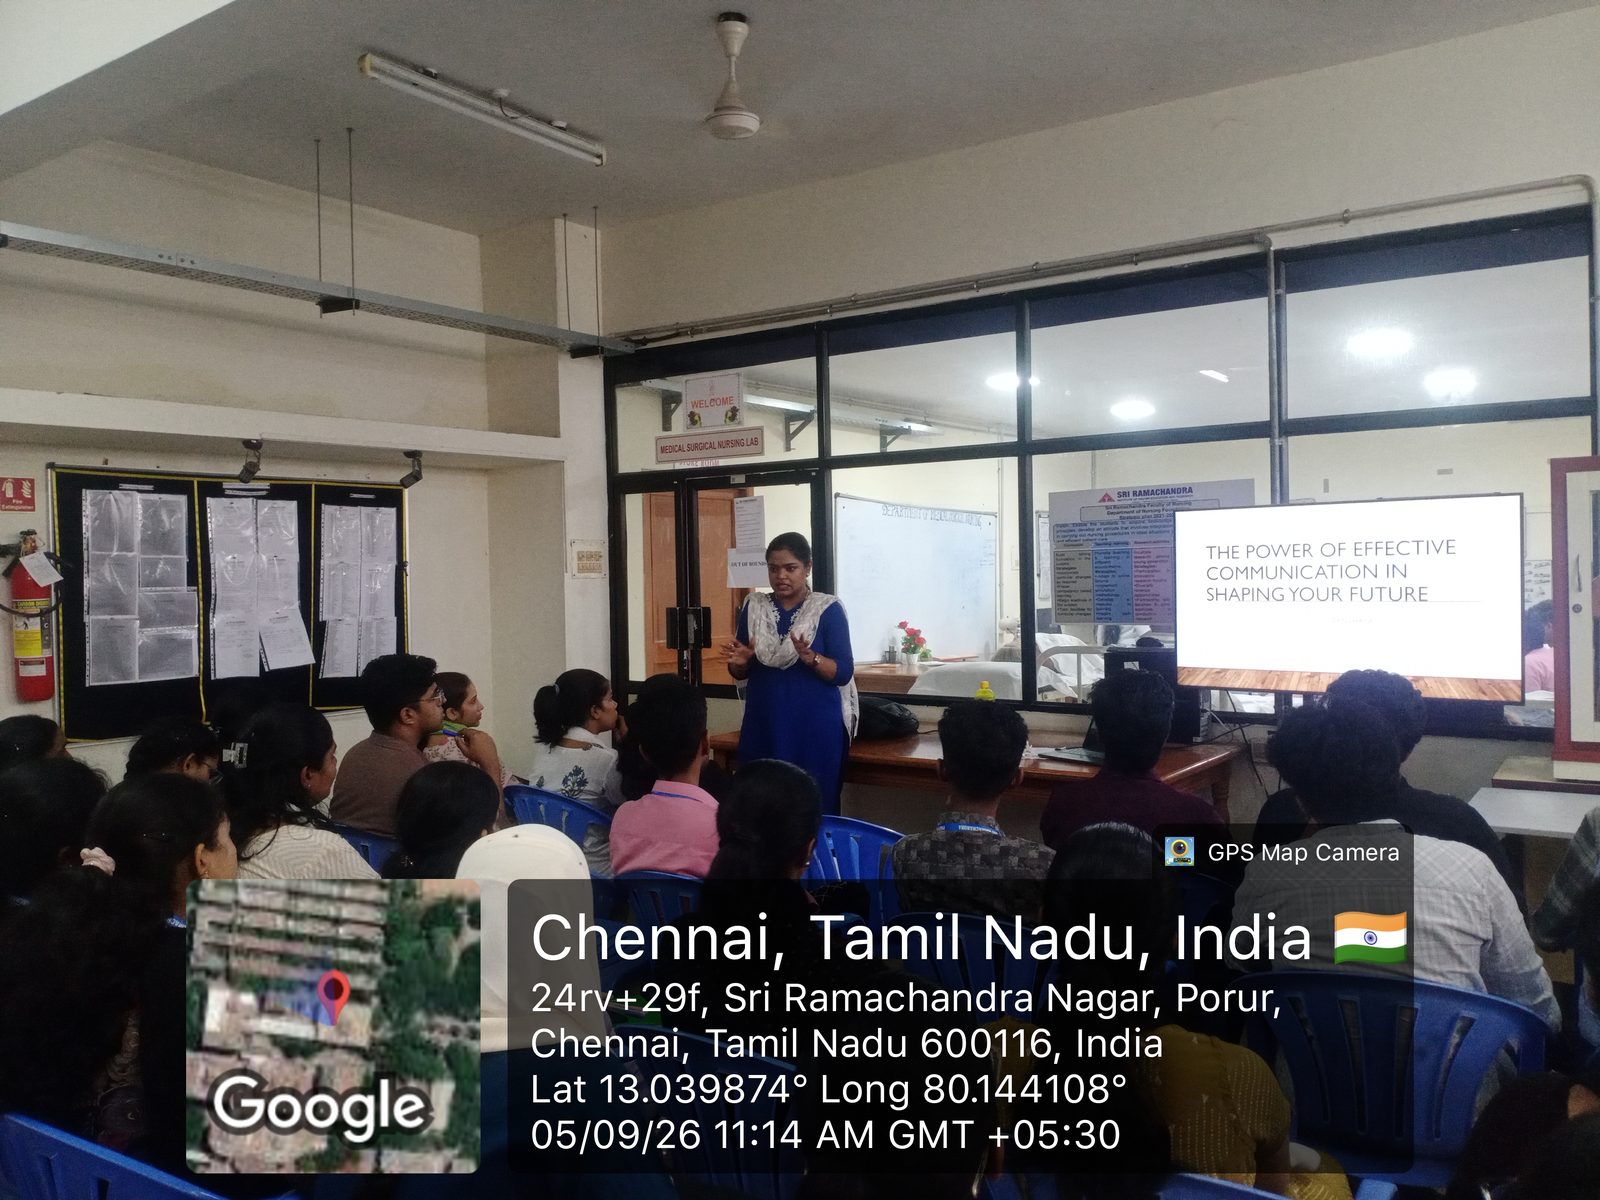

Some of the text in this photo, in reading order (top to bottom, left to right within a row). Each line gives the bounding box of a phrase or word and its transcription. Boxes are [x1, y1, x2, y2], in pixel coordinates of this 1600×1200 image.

[691, 396, 734, 409] WELCOME
[661, 437, 759, 454] MEDICAL SURGICAL NURSING LAB
[1133, 487, 1193, 497] RAMACHANDRA
[1206, 539, 1457, 560] THE POWER OF EFFECTIVE
[1206, 563, 1407, 581] COMMUNICATION IN
[1206, 586, 1429, 602] SHAPING YOUR FUTURE
